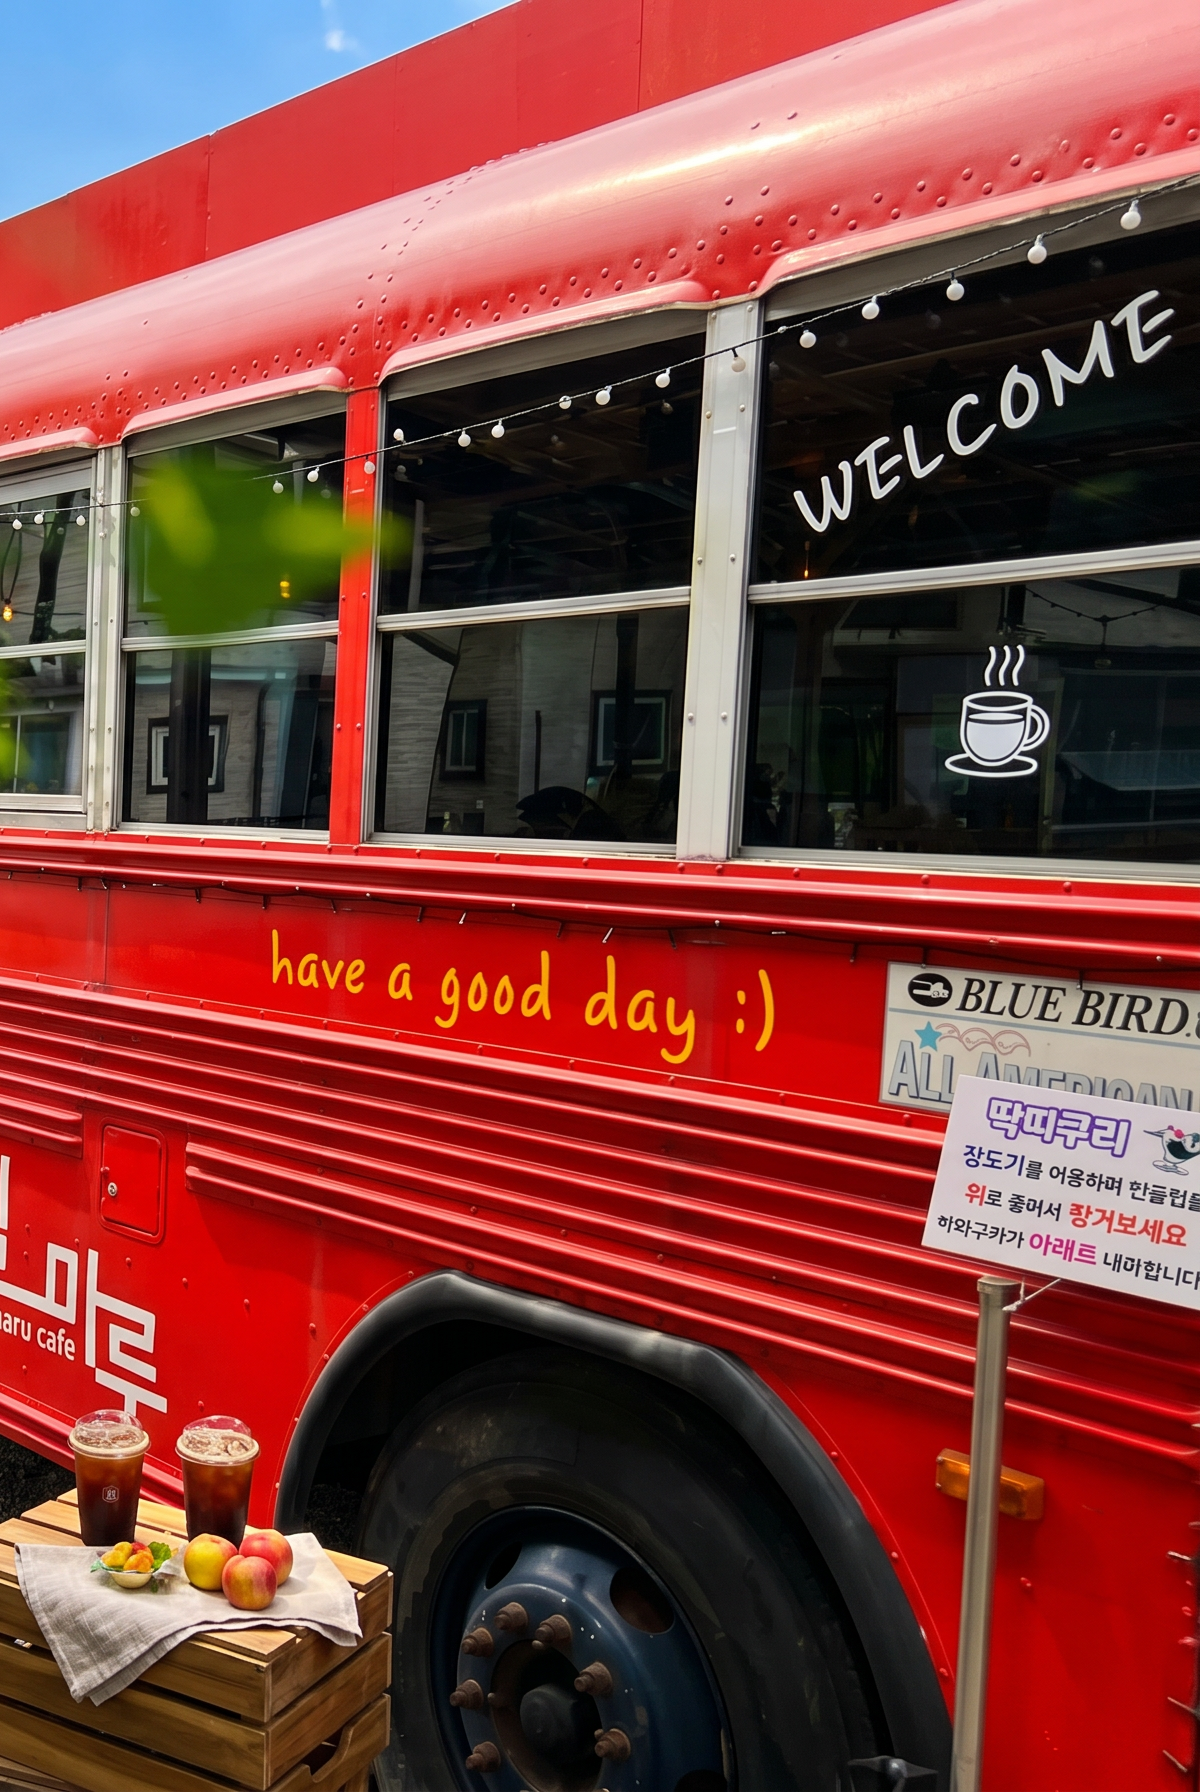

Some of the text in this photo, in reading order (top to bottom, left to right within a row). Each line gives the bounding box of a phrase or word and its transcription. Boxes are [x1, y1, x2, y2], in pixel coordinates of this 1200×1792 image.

[793, 289, 1174, 533] WELCOME
[271, 929, 365, 994] have
[387, 962, 413, 1001] a
[434, 950, 551, 1029] good
[584, 955, 696, 1064] day
[955, 977, 1066, 1022] BLUE
[888, 1039, 954, 1104] ALL
[965, 1183, 1002, 1207] 위로
[36, 1326, 76, 1361] cafe
